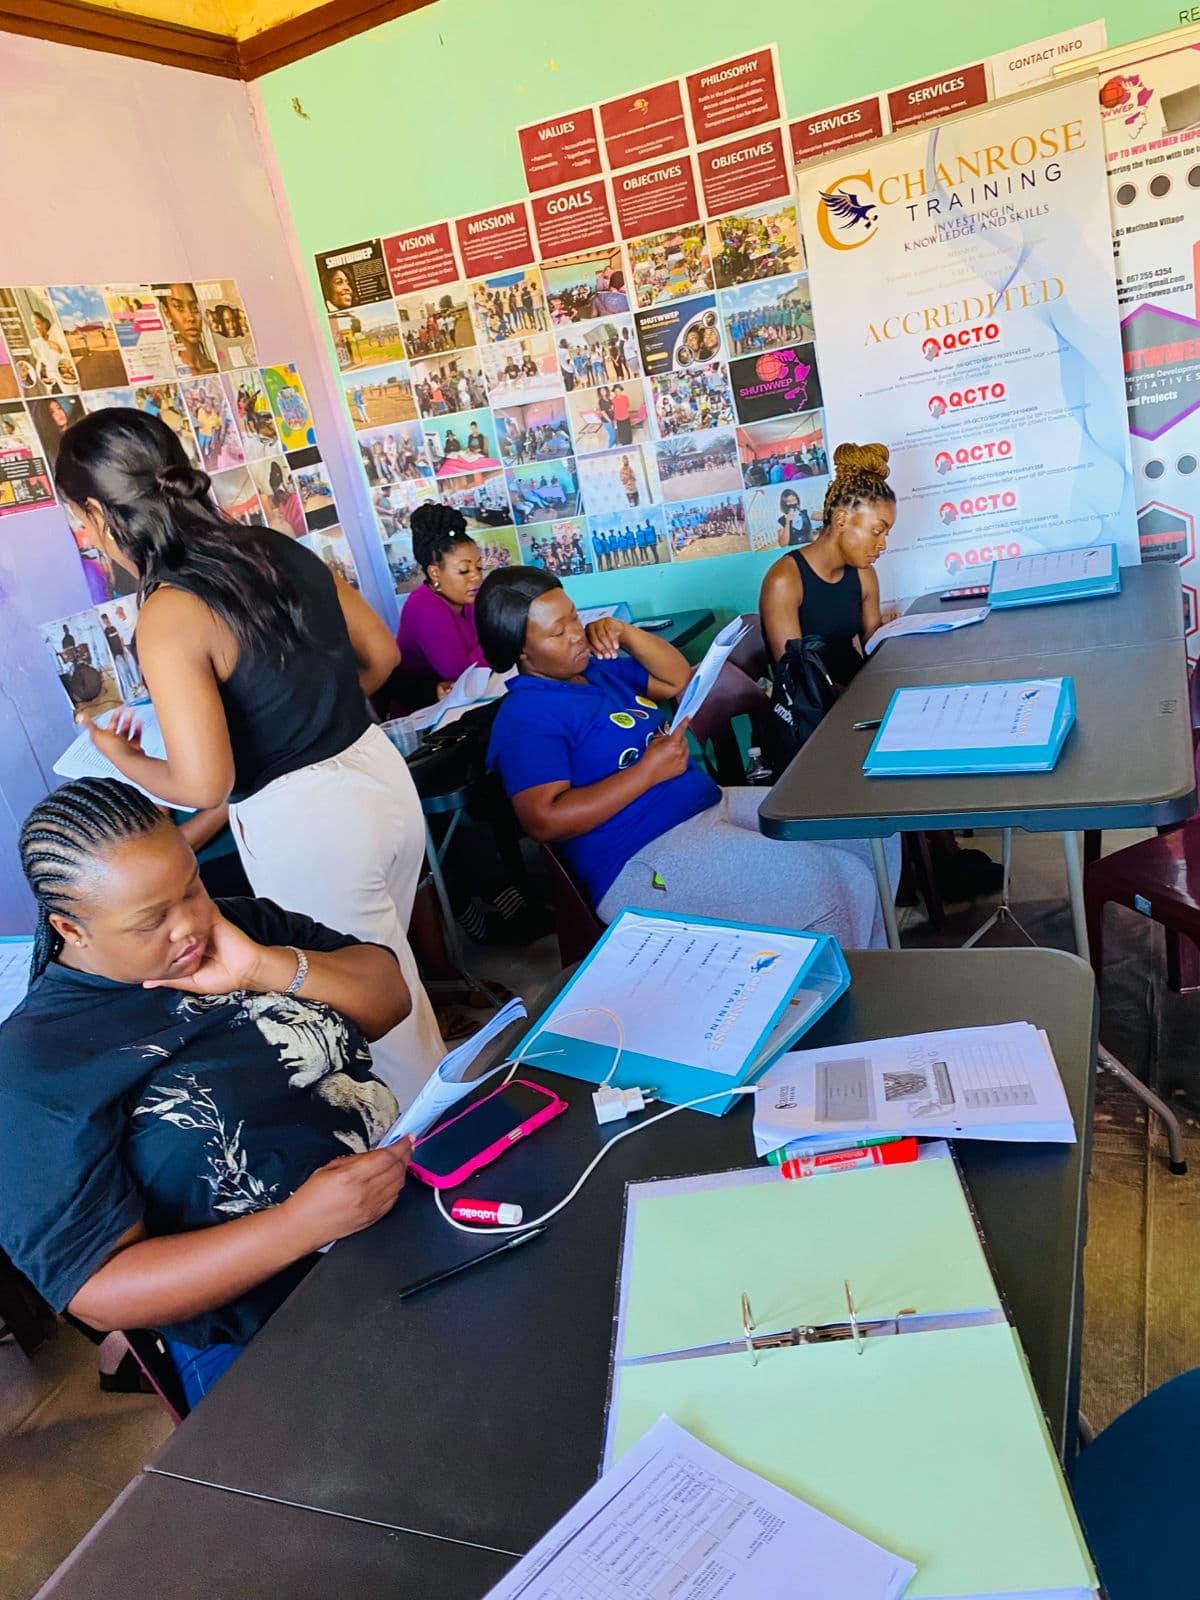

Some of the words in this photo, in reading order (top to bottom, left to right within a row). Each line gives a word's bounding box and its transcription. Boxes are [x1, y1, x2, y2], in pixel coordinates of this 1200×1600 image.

[1008, 48, 1054, 71] CONTACT
[1058, 40, 1083, 55] INFO
[700, 59, 758, 88] PHILOSOPHY
[907, 76, 965, 105] SERVICES
[538, 121, 575, 141] VALUES
[808, 109, 861, 136] SERVICES
[711, 142, 774, 170] OBJECTIVES
[877, 118, 1087, 206] CHANROSE
[623, 165, 682, 191] OBJECTIVES
[546, 190, 592, 215] GOALS
[906, 162, 1063, 222] TRAINING
[468, 211, 515, 235] MISSION
[904, 221, 976, 252] KNOWLEDGE
[980, 217, 1007, 233] AND
[1010, 204, 1050, 223] SKILLS
[933, 208, 998, 234] INVESTING
[1001, 203, 1014, 216] IN
[398, 232, 436, 252] VISION
[863, 277, 1066, 347] ACCREDITED
[942, 322, 1000, 350] QCTO
[739, 378, 793, 397] SHUTWWEP
[949, 382, 1006, 408] QCTO
[1141, 391, 1178, 405] Projects
[955, 439, 1013, 465] QCTO
[959, 491, 1016, 515] QCTO
[964, 543, 1021, 565] QCTO
[704, 982, 745, 1040] TRAINING
